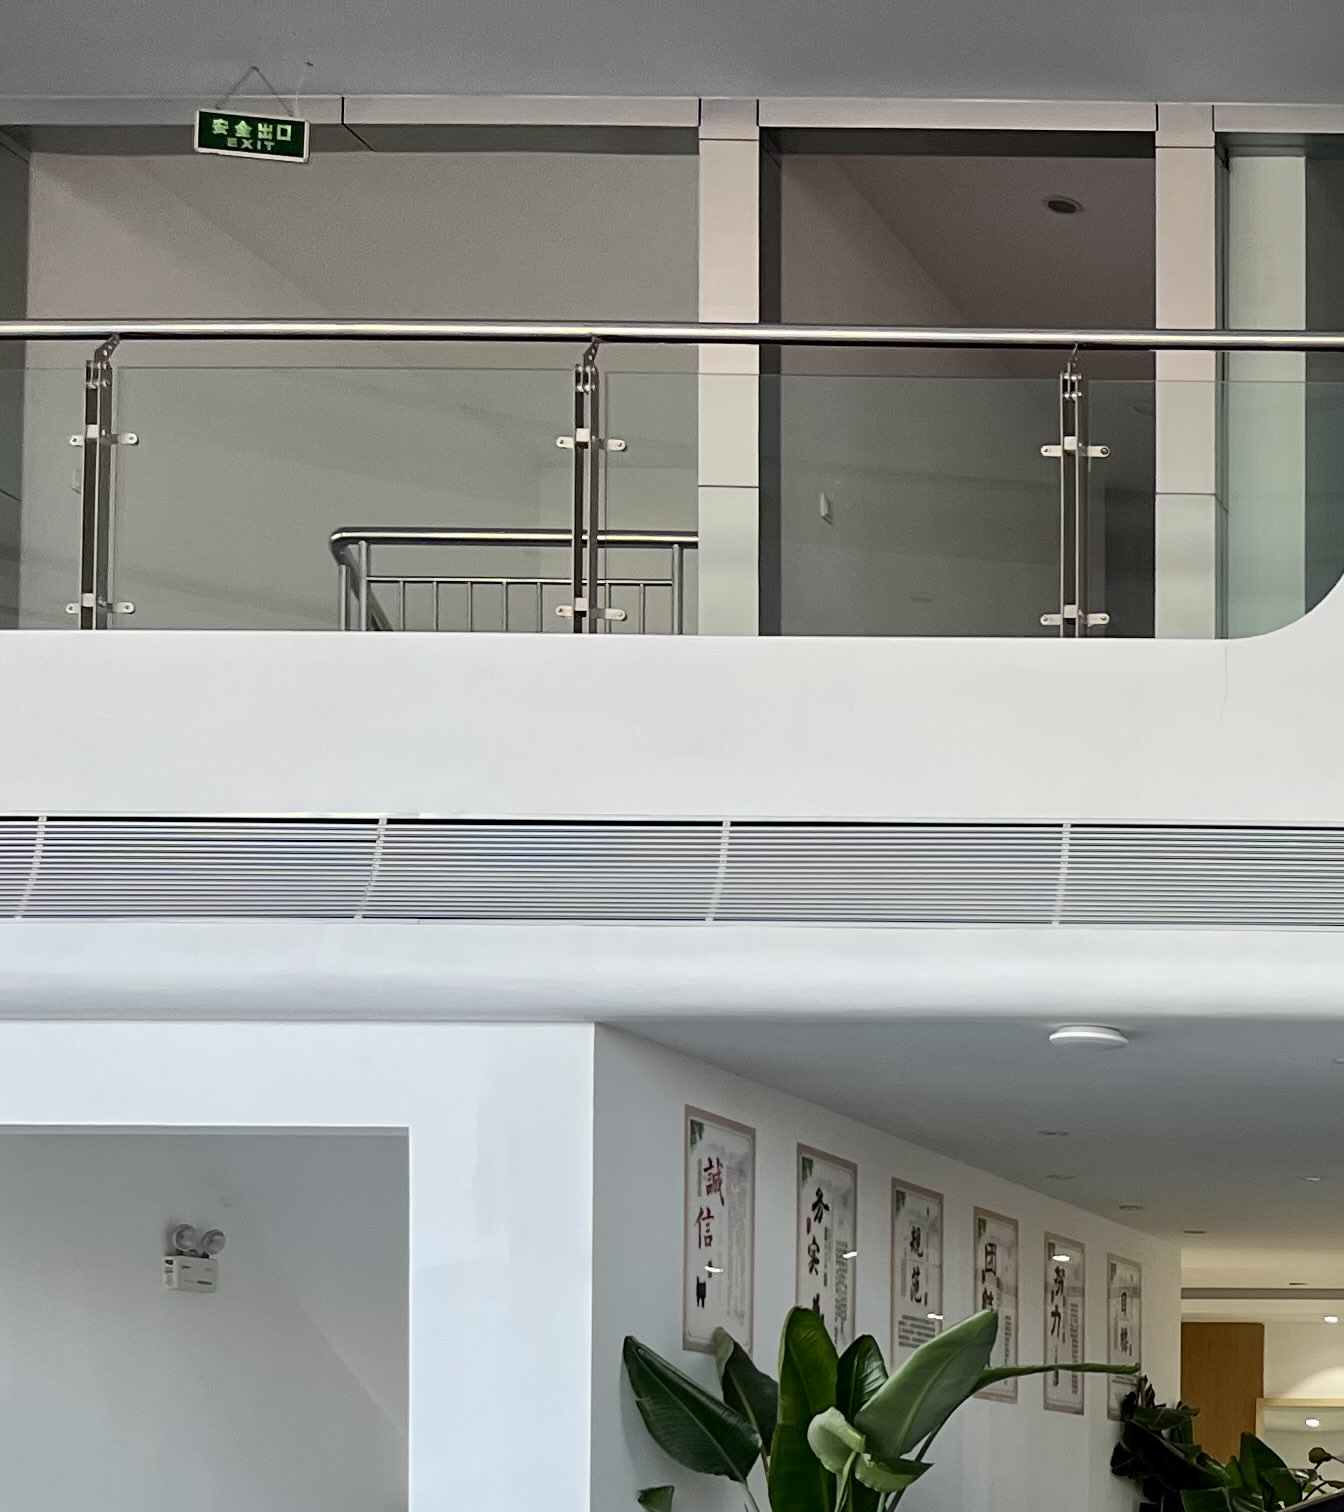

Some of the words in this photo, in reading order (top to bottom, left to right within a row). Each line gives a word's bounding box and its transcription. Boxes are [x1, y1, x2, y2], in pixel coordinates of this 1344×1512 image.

[212, 118, 292, 142] 安全出口
[227, 137, 275, 151] EXIT
